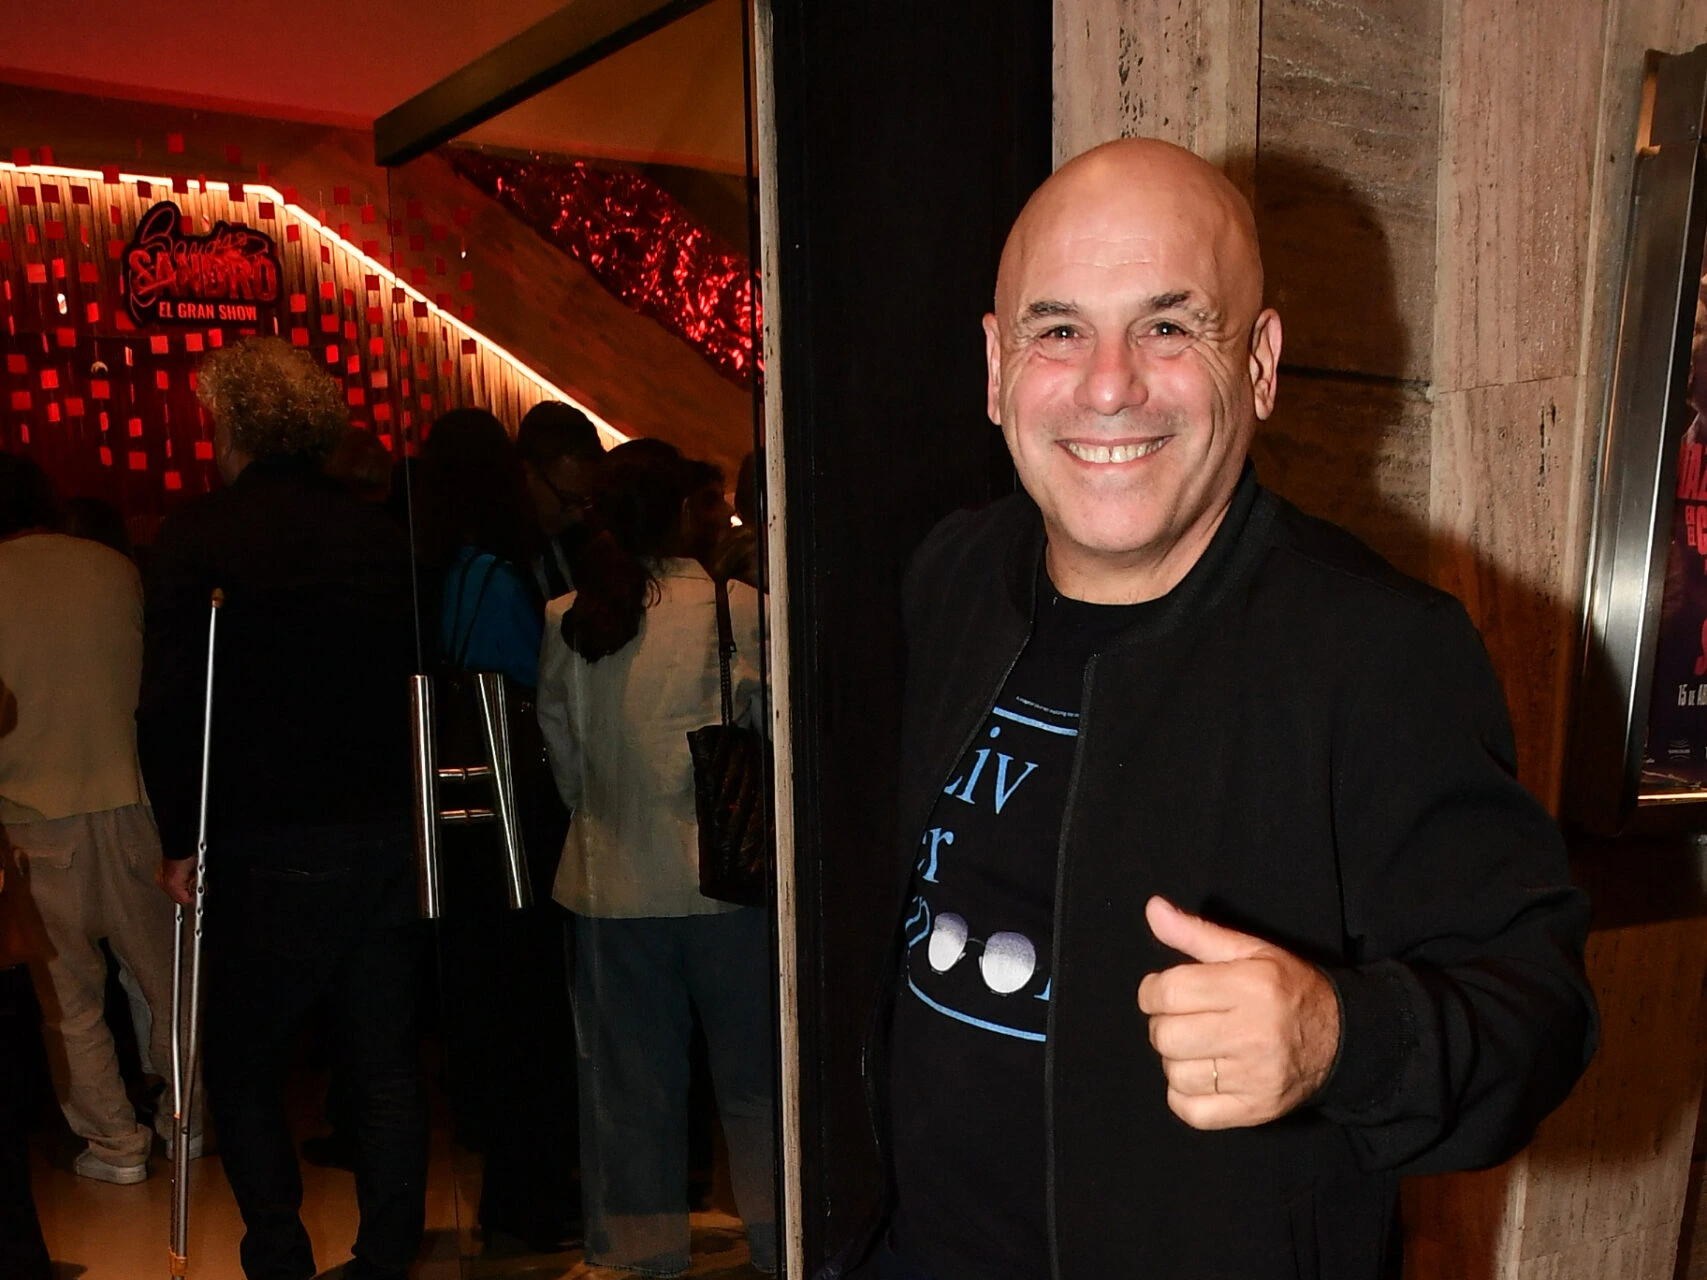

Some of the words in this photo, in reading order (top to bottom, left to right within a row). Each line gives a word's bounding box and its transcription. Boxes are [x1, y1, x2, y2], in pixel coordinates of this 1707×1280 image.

[129, 250, 277, 301] SANDRO
[159, 301, 173, 318] EL
[178, 303, 214, 319] GRAN
[219, 304, 257, 321] SHOW
[1677, 683, 1688, 706] 15
[943, 726, 1039, 815] iv
[917, 827, 955, 883] r
